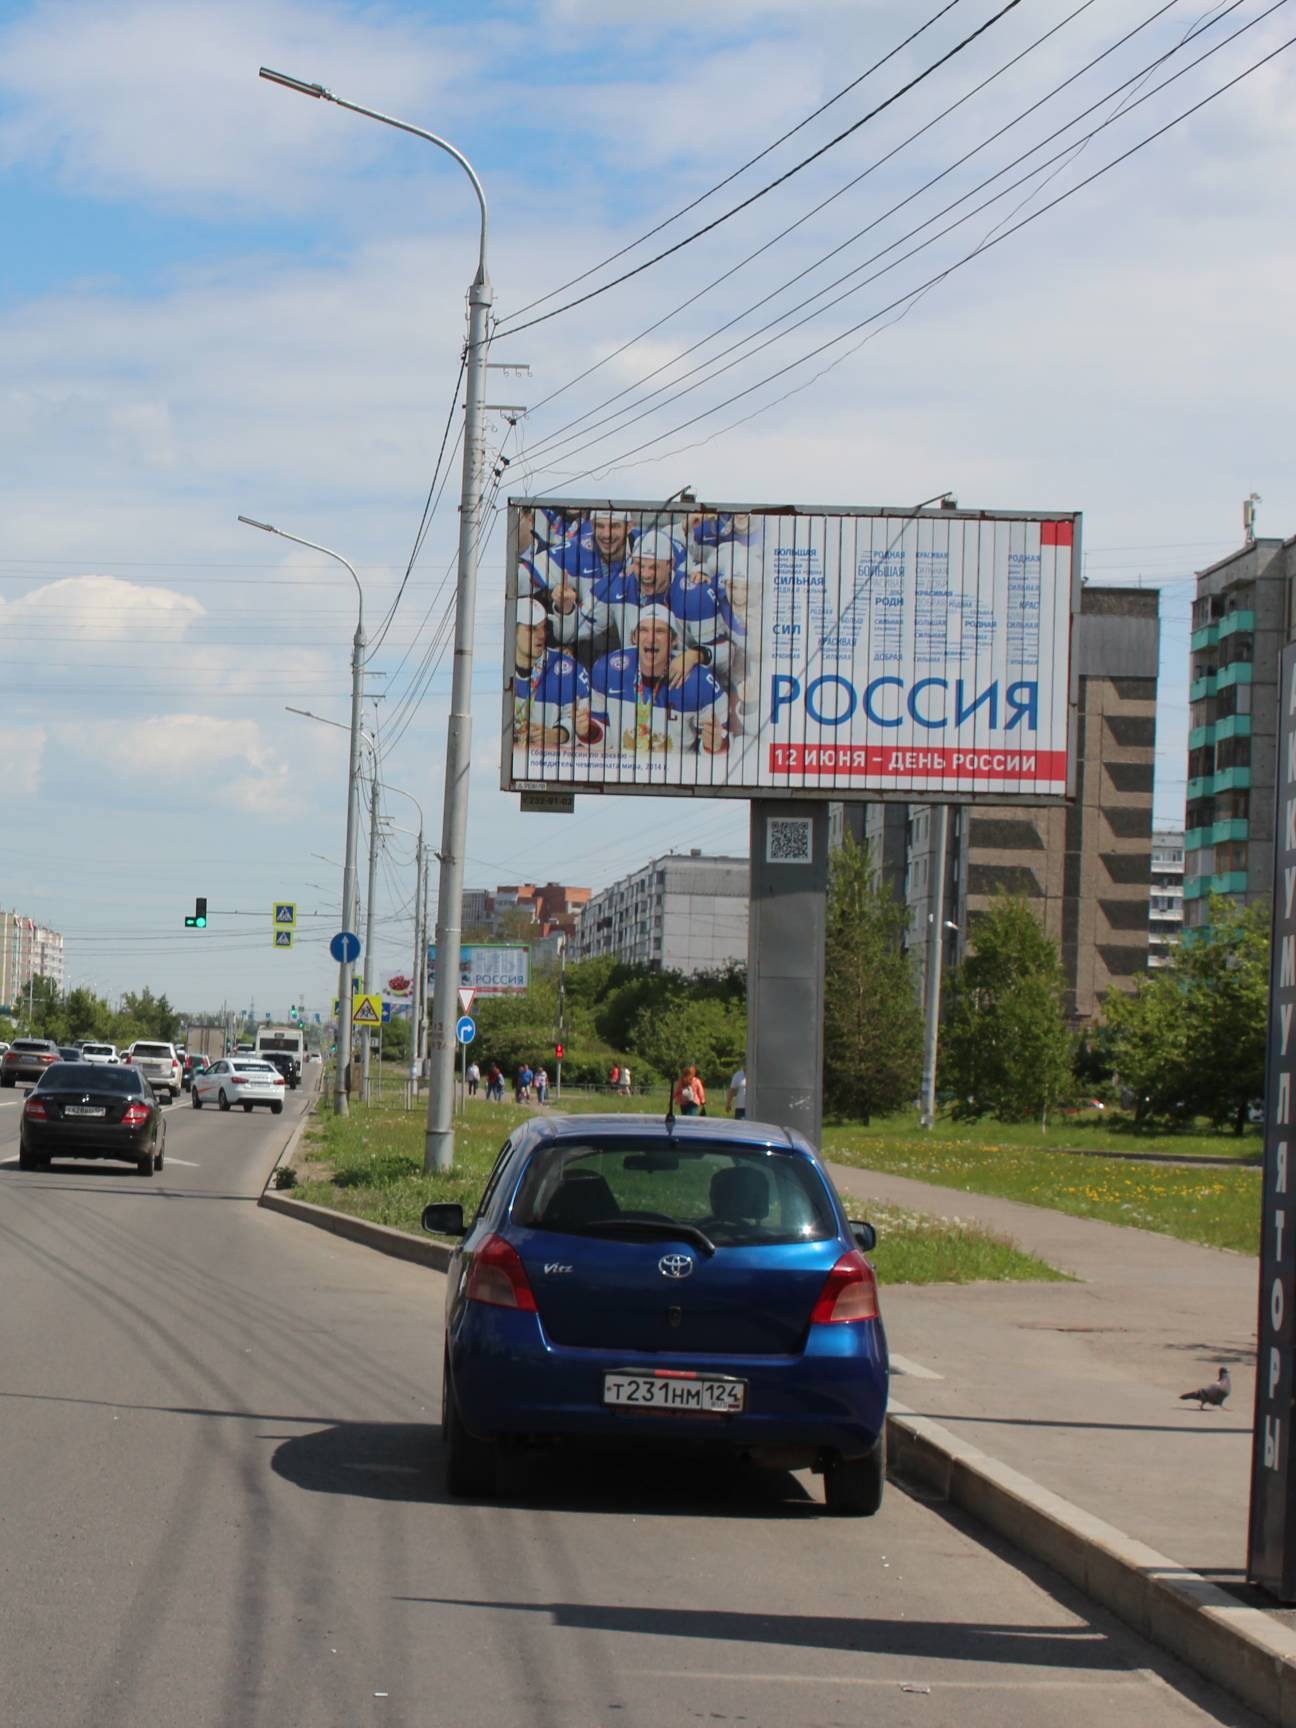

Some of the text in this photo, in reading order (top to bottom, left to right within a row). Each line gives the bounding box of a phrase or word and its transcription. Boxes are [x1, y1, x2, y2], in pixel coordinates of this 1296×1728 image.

[770, 673, 1039, 731] РОССИЯ
[775, 750, 797, 766] 12
[804, 750, 865, 768] ИЮНЯ
[888, 752, 946, 771] ДЕНЬ
[952, 755, 1037, 773] РОССИИ
[475, 975, 524, 985] РОССИЯ
[612, 1381, 737, 1405] Т231НМ 124
